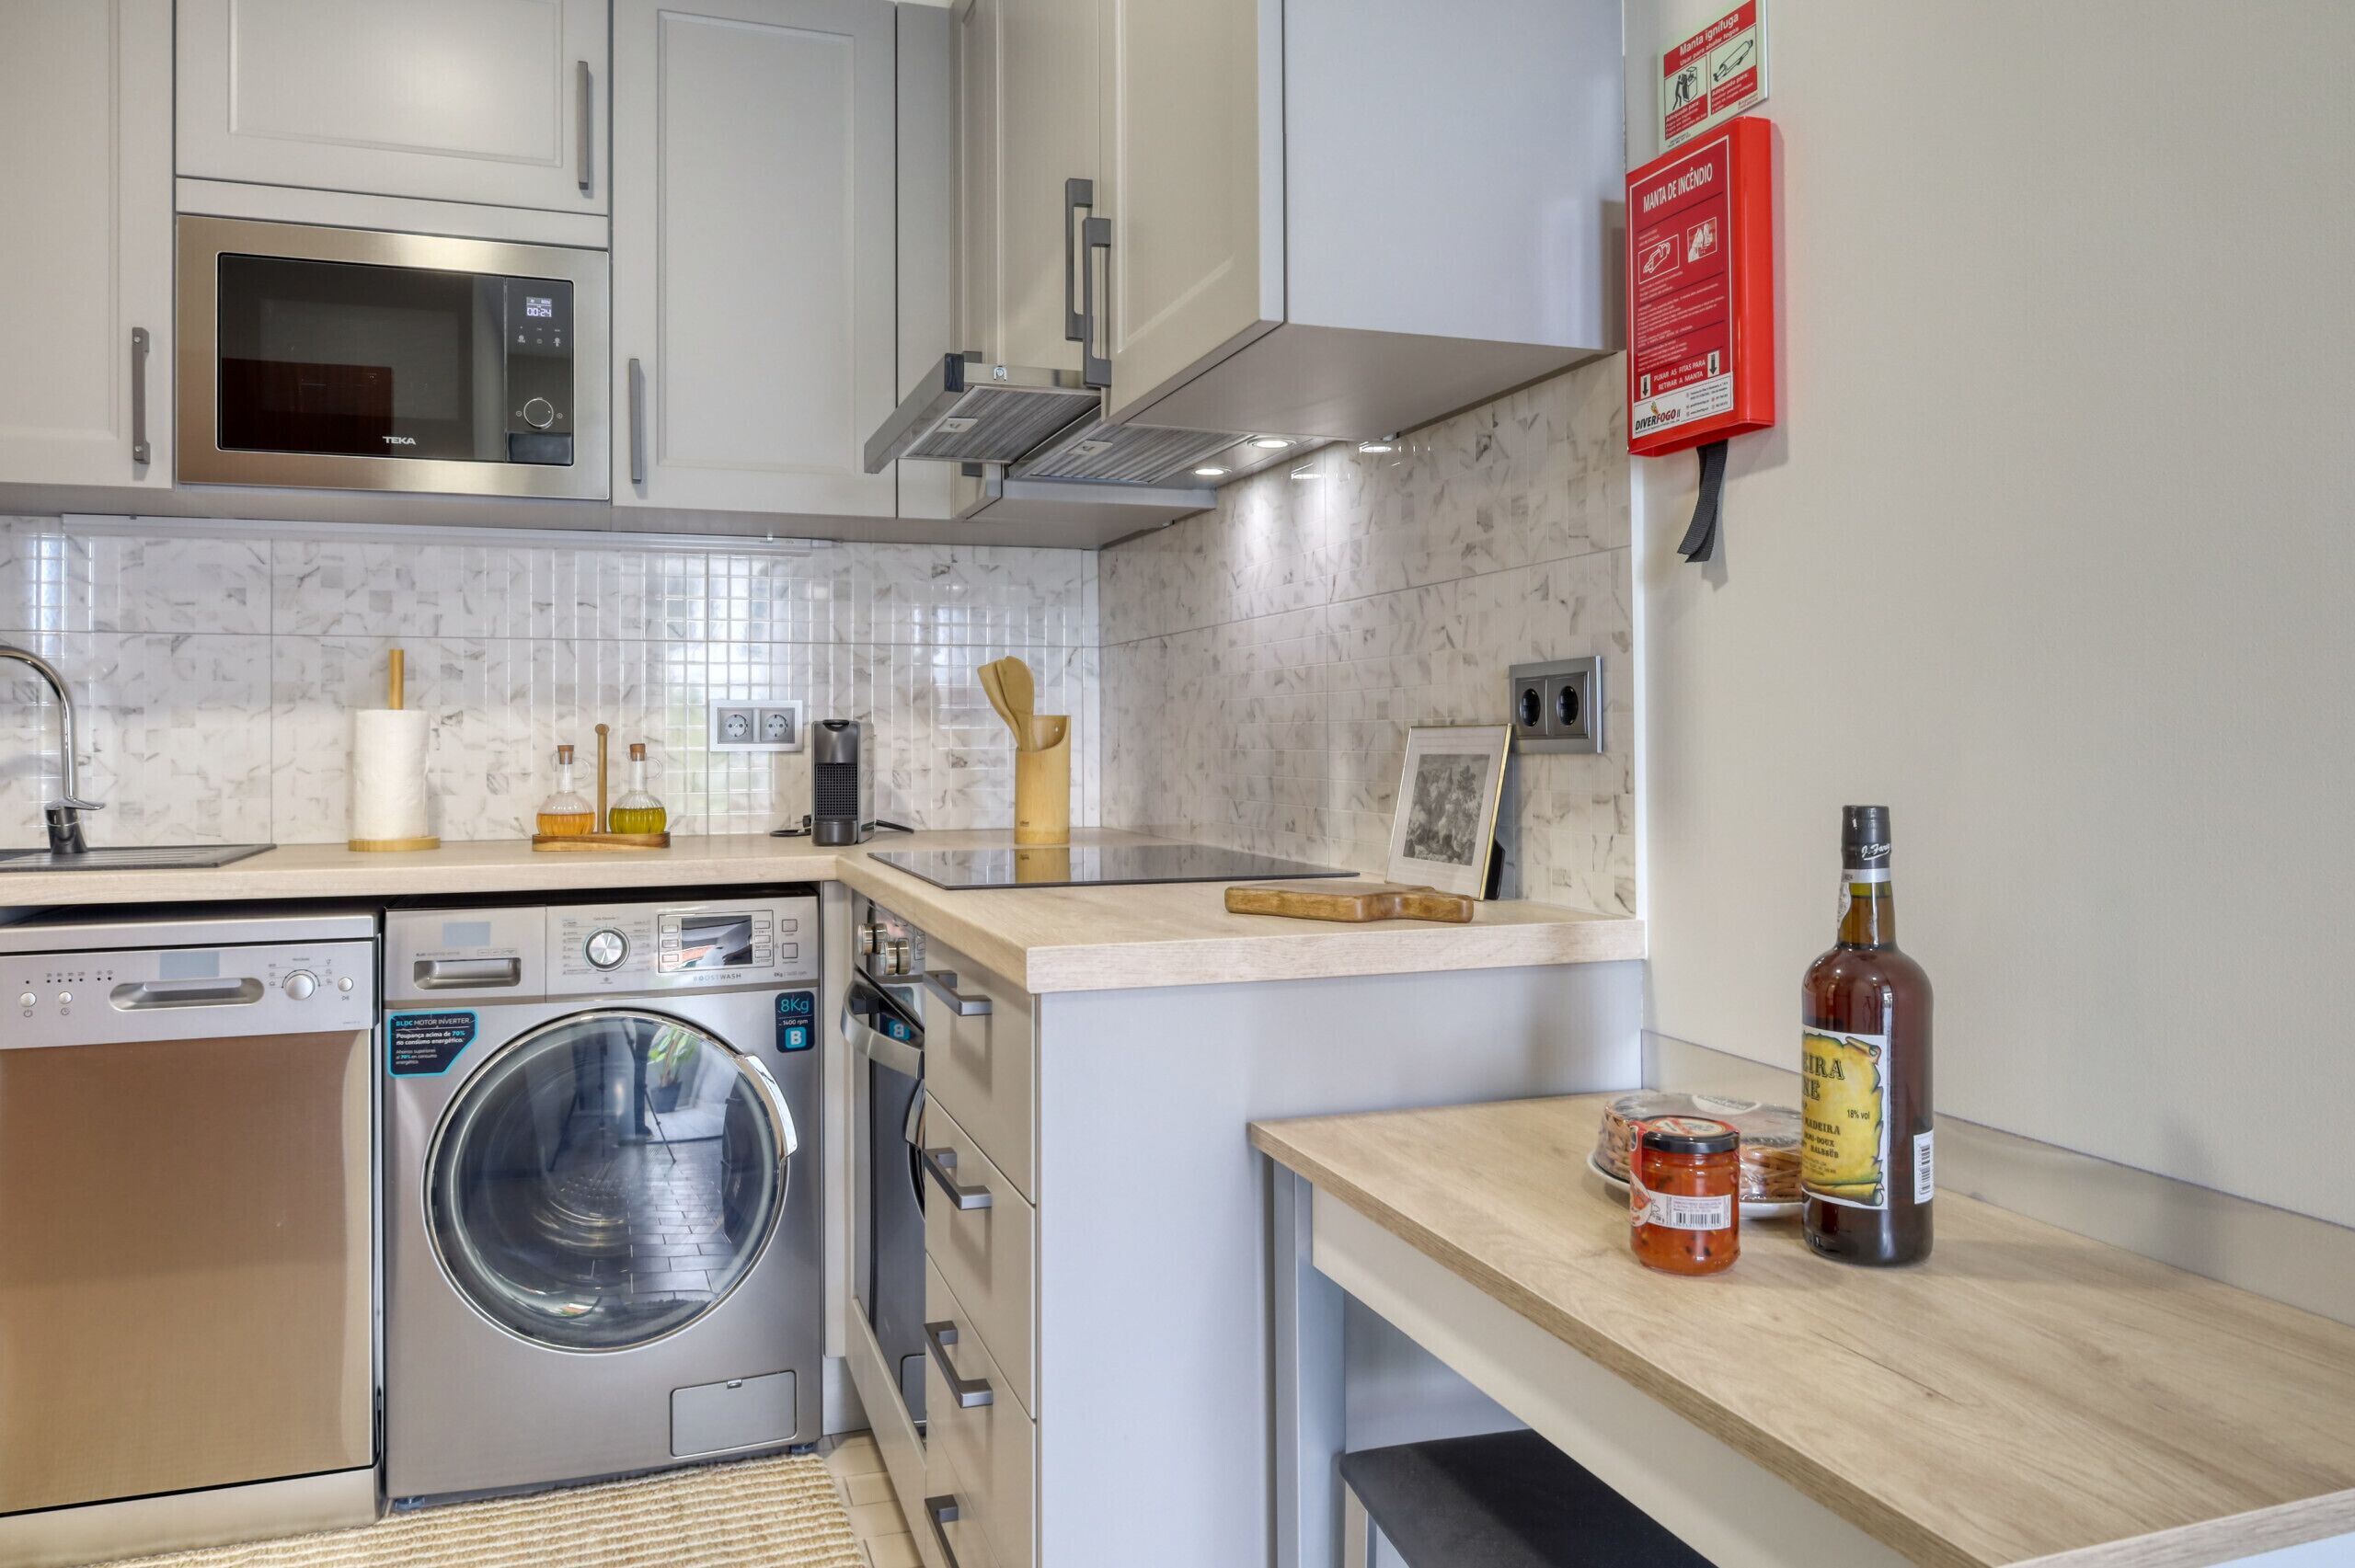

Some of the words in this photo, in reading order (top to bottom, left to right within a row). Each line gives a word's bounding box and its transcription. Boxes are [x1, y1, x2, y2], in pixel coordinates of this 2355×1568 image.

[1679, 35, 1704, 56] Manta
[1643, 186, 1667, 213] MANTA
[1668, 179, 1677, 201] DE
[1678, 163, 1713, 196] INCÊNDIO
[526, 307, 552, 317] 00:24
[1671, 368, 1677, 377] AS
[1692, 360, 1706, 370] PARA
[1658, 381, 1678, 391] RETIRAR
[1684, 371, 1704, 383] MANTA
[1635, 408, 1677, 431] DIVERFOGO
[382, 436, 417, 445] TEKA
[780, 998, 810, 1014] 8Kg
[413, 1018, 437, 1026] MOTOR
[790, 1030, 802, 1046] B
[1860, 1110, 1870, 1120] vol
